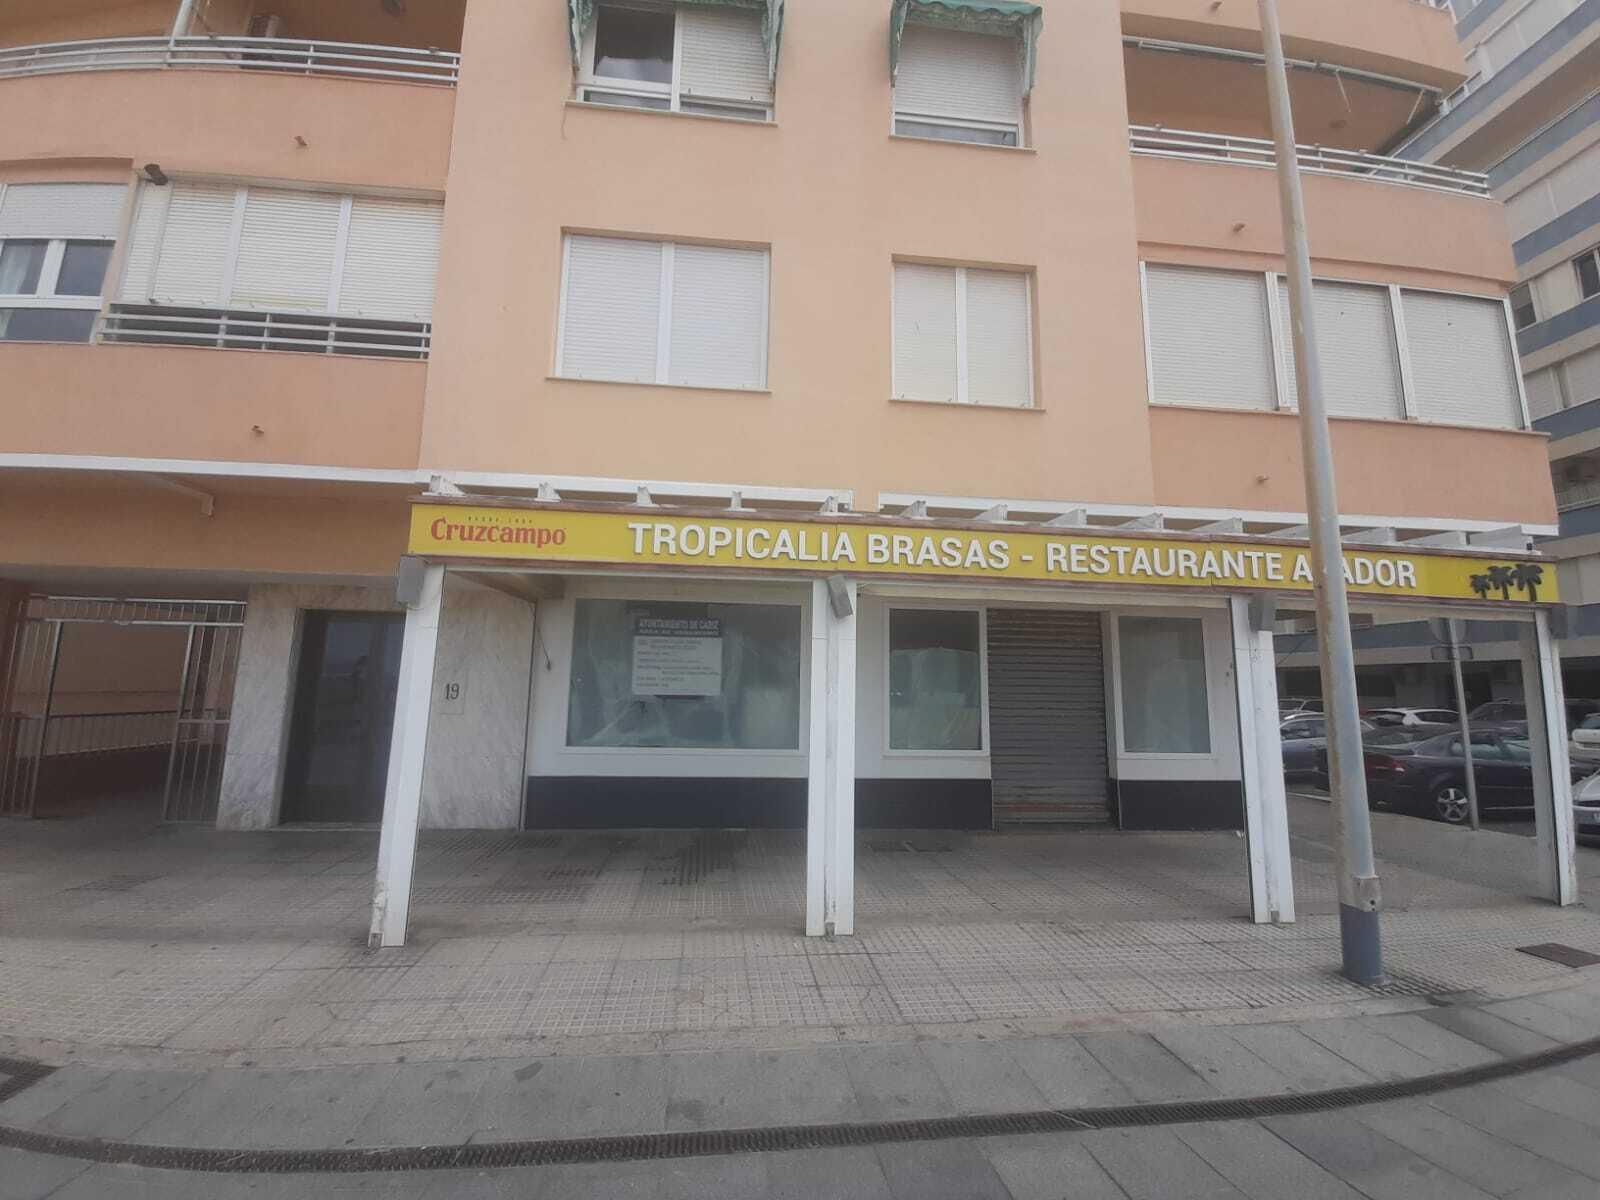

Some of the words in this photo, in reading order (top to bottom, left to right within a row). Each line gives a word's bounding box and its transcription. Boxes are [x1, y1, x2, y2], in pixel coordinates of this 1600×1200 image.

[431, 516, 566, 548] Cruzcampo
[628, 523, 856, 563] TROPICALIA
[867, 534, 1010, 570] BRASAS
[1046, 543, 1284, 581] RESTAURANTE
[1292, 554, 1417, 588] AADOR
[445, 683, 460, 700] 19
